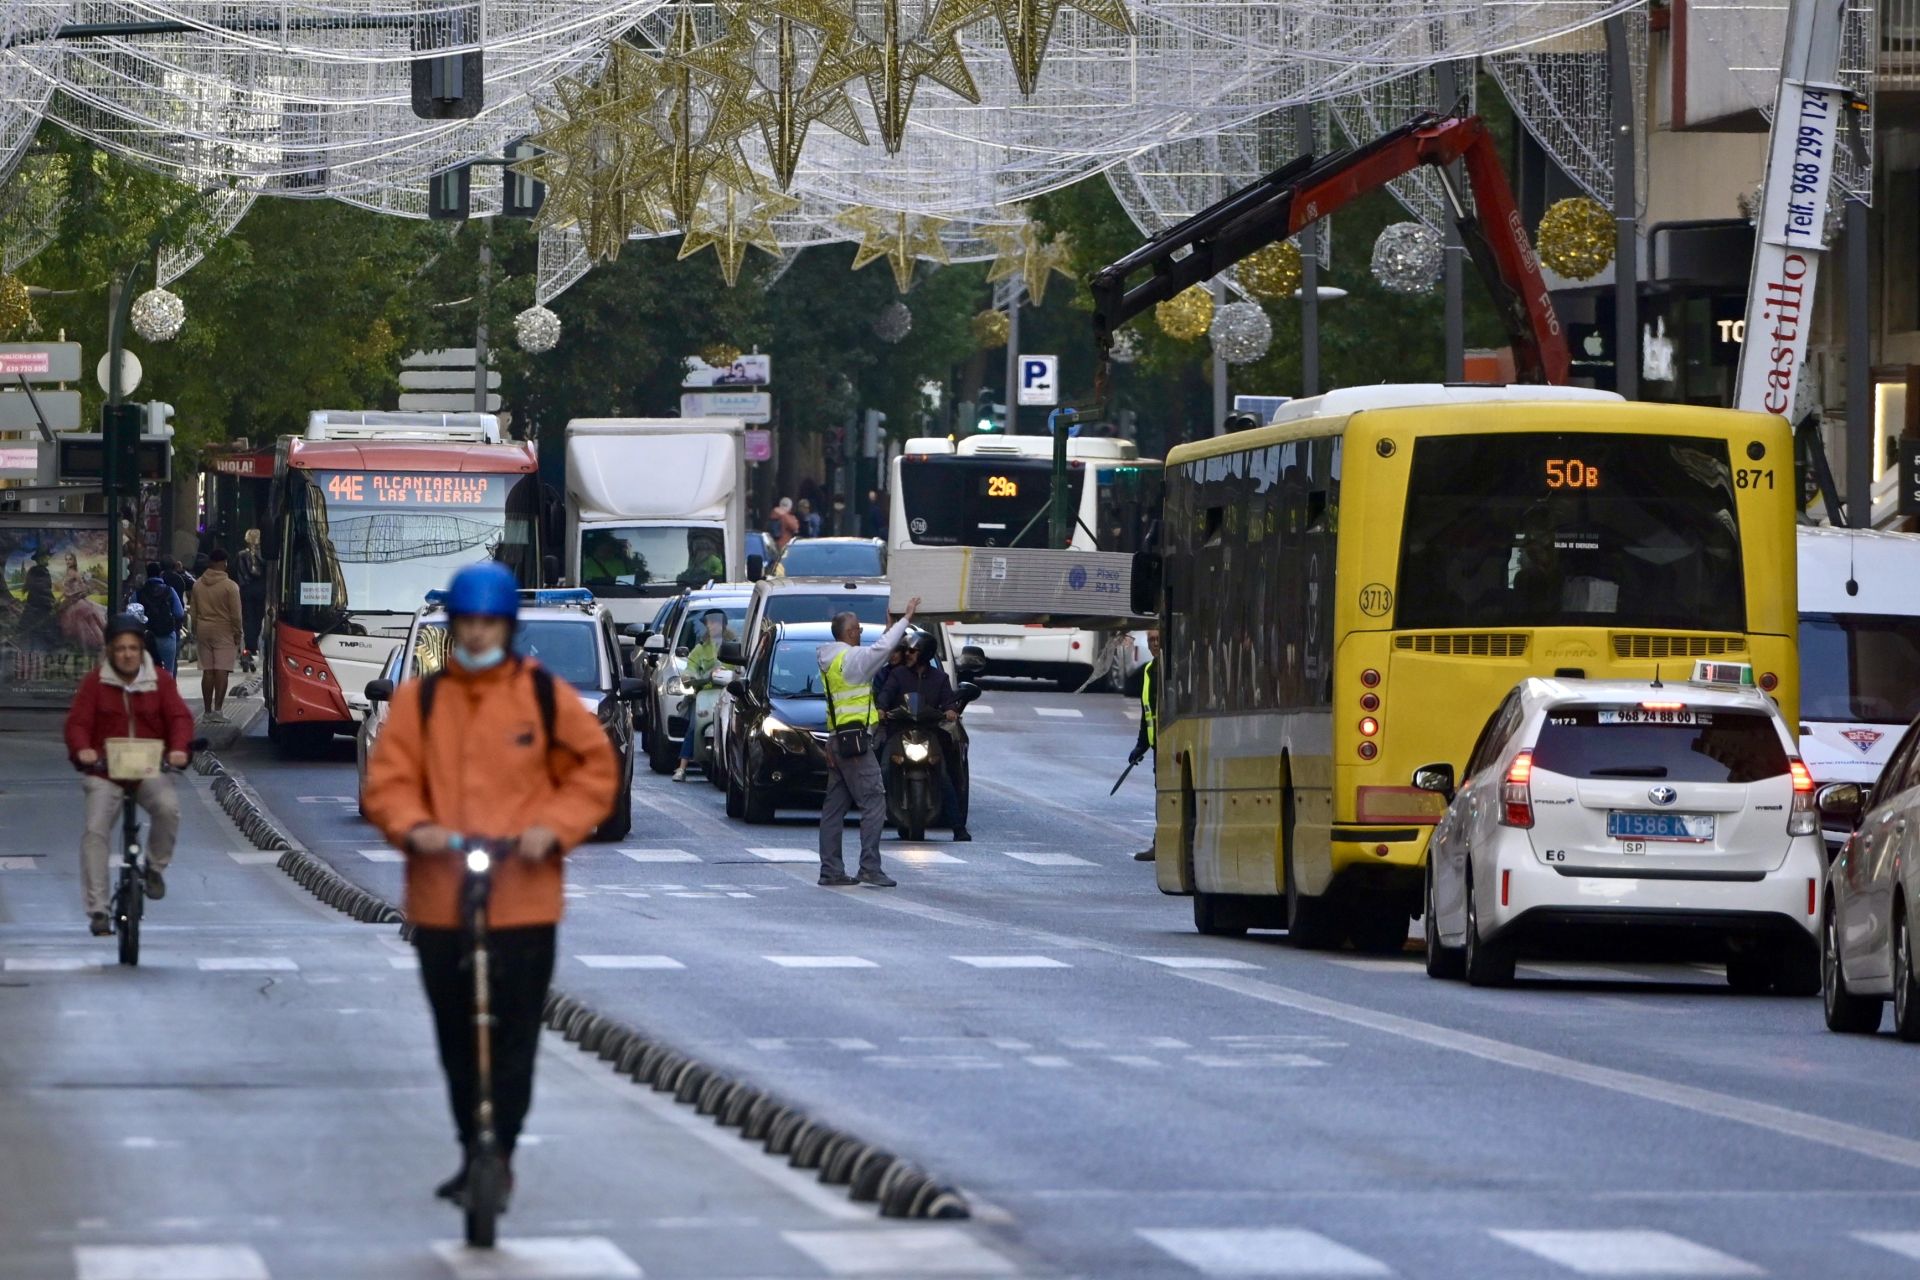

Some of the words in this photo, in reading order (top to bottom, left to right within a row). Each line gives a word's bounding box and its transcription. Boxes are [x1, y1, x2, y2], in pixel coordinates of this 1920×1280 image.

[1801, 90, 1829, 119] 124
[1795, 126, 1824, 158] 299
[1790, 163, 1820, 194] 968
[1784, 201, 1815, 236] Telf.
[1764, 254, 1807, 415] castillo
[1025, 361, 1047, 388] P
[373, 476, 488, 491] ALCANTARILLA
[1546, 459, 1598, 487] 50B
[1736, 469, 1774, 489] 871
[328, 475, 363, 500] 44E
[379, 489, 406, 502] LAS
[415, 490, 482, 503] TEJERAS
[1363, 590, 1389, 610] 3713
[1618, 711, 1639, 721] 968
[1643, 711, 1656, 721] 24
[1660, 712, 1674, 722] 88
[1677, 713, 1691, 723] 00
[1624, 816, 1668, 835] 1586
[1626, 842, 1643, 853] SP
